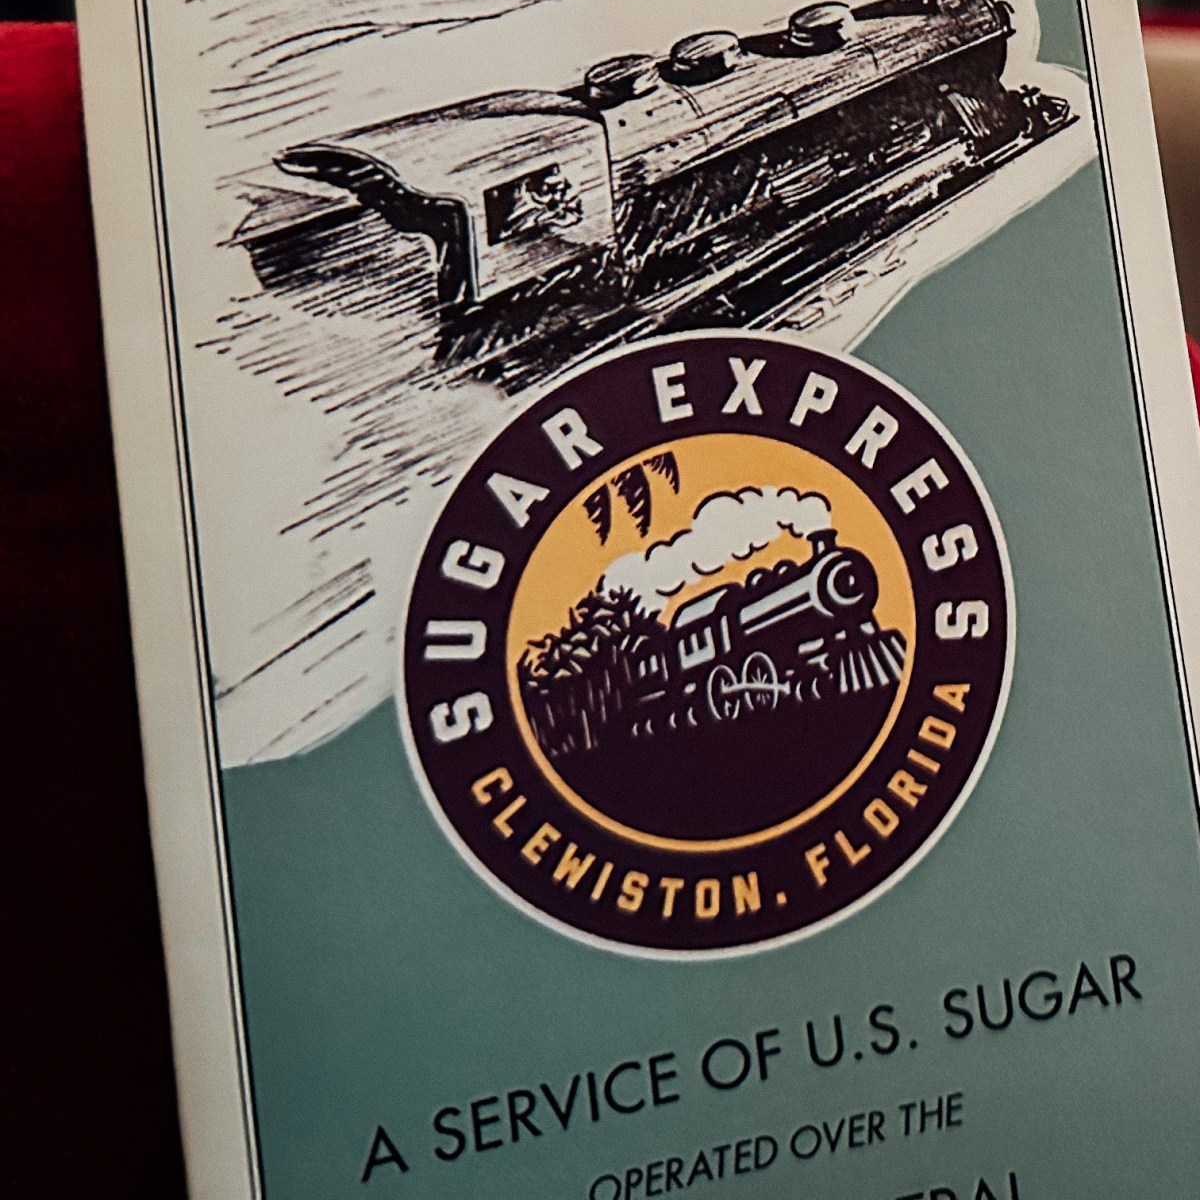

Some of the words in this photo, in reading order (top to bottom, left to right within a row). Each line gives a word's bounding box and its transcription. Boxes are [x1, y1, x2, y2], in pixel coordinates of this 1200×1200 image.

[425, 407, 605, 744] SUGAR
[651, 357, 990, 641] EXPRESS
[804, 681, 971, 887] FLORIDA
[361, 1126, 409, 1182] A
[432, 1052, 680, 1161] SERVICE
[701, 1028, 782, 1090] OF
[806, 1005, 918, 1067] U.S.
[943, 953, 1142, 1039] SUGAR
[589, 1135, 778, 1200] OPERATED
[790, 1110, 886, 1159] OVER
[899, 1092, 963, 1136] THE
